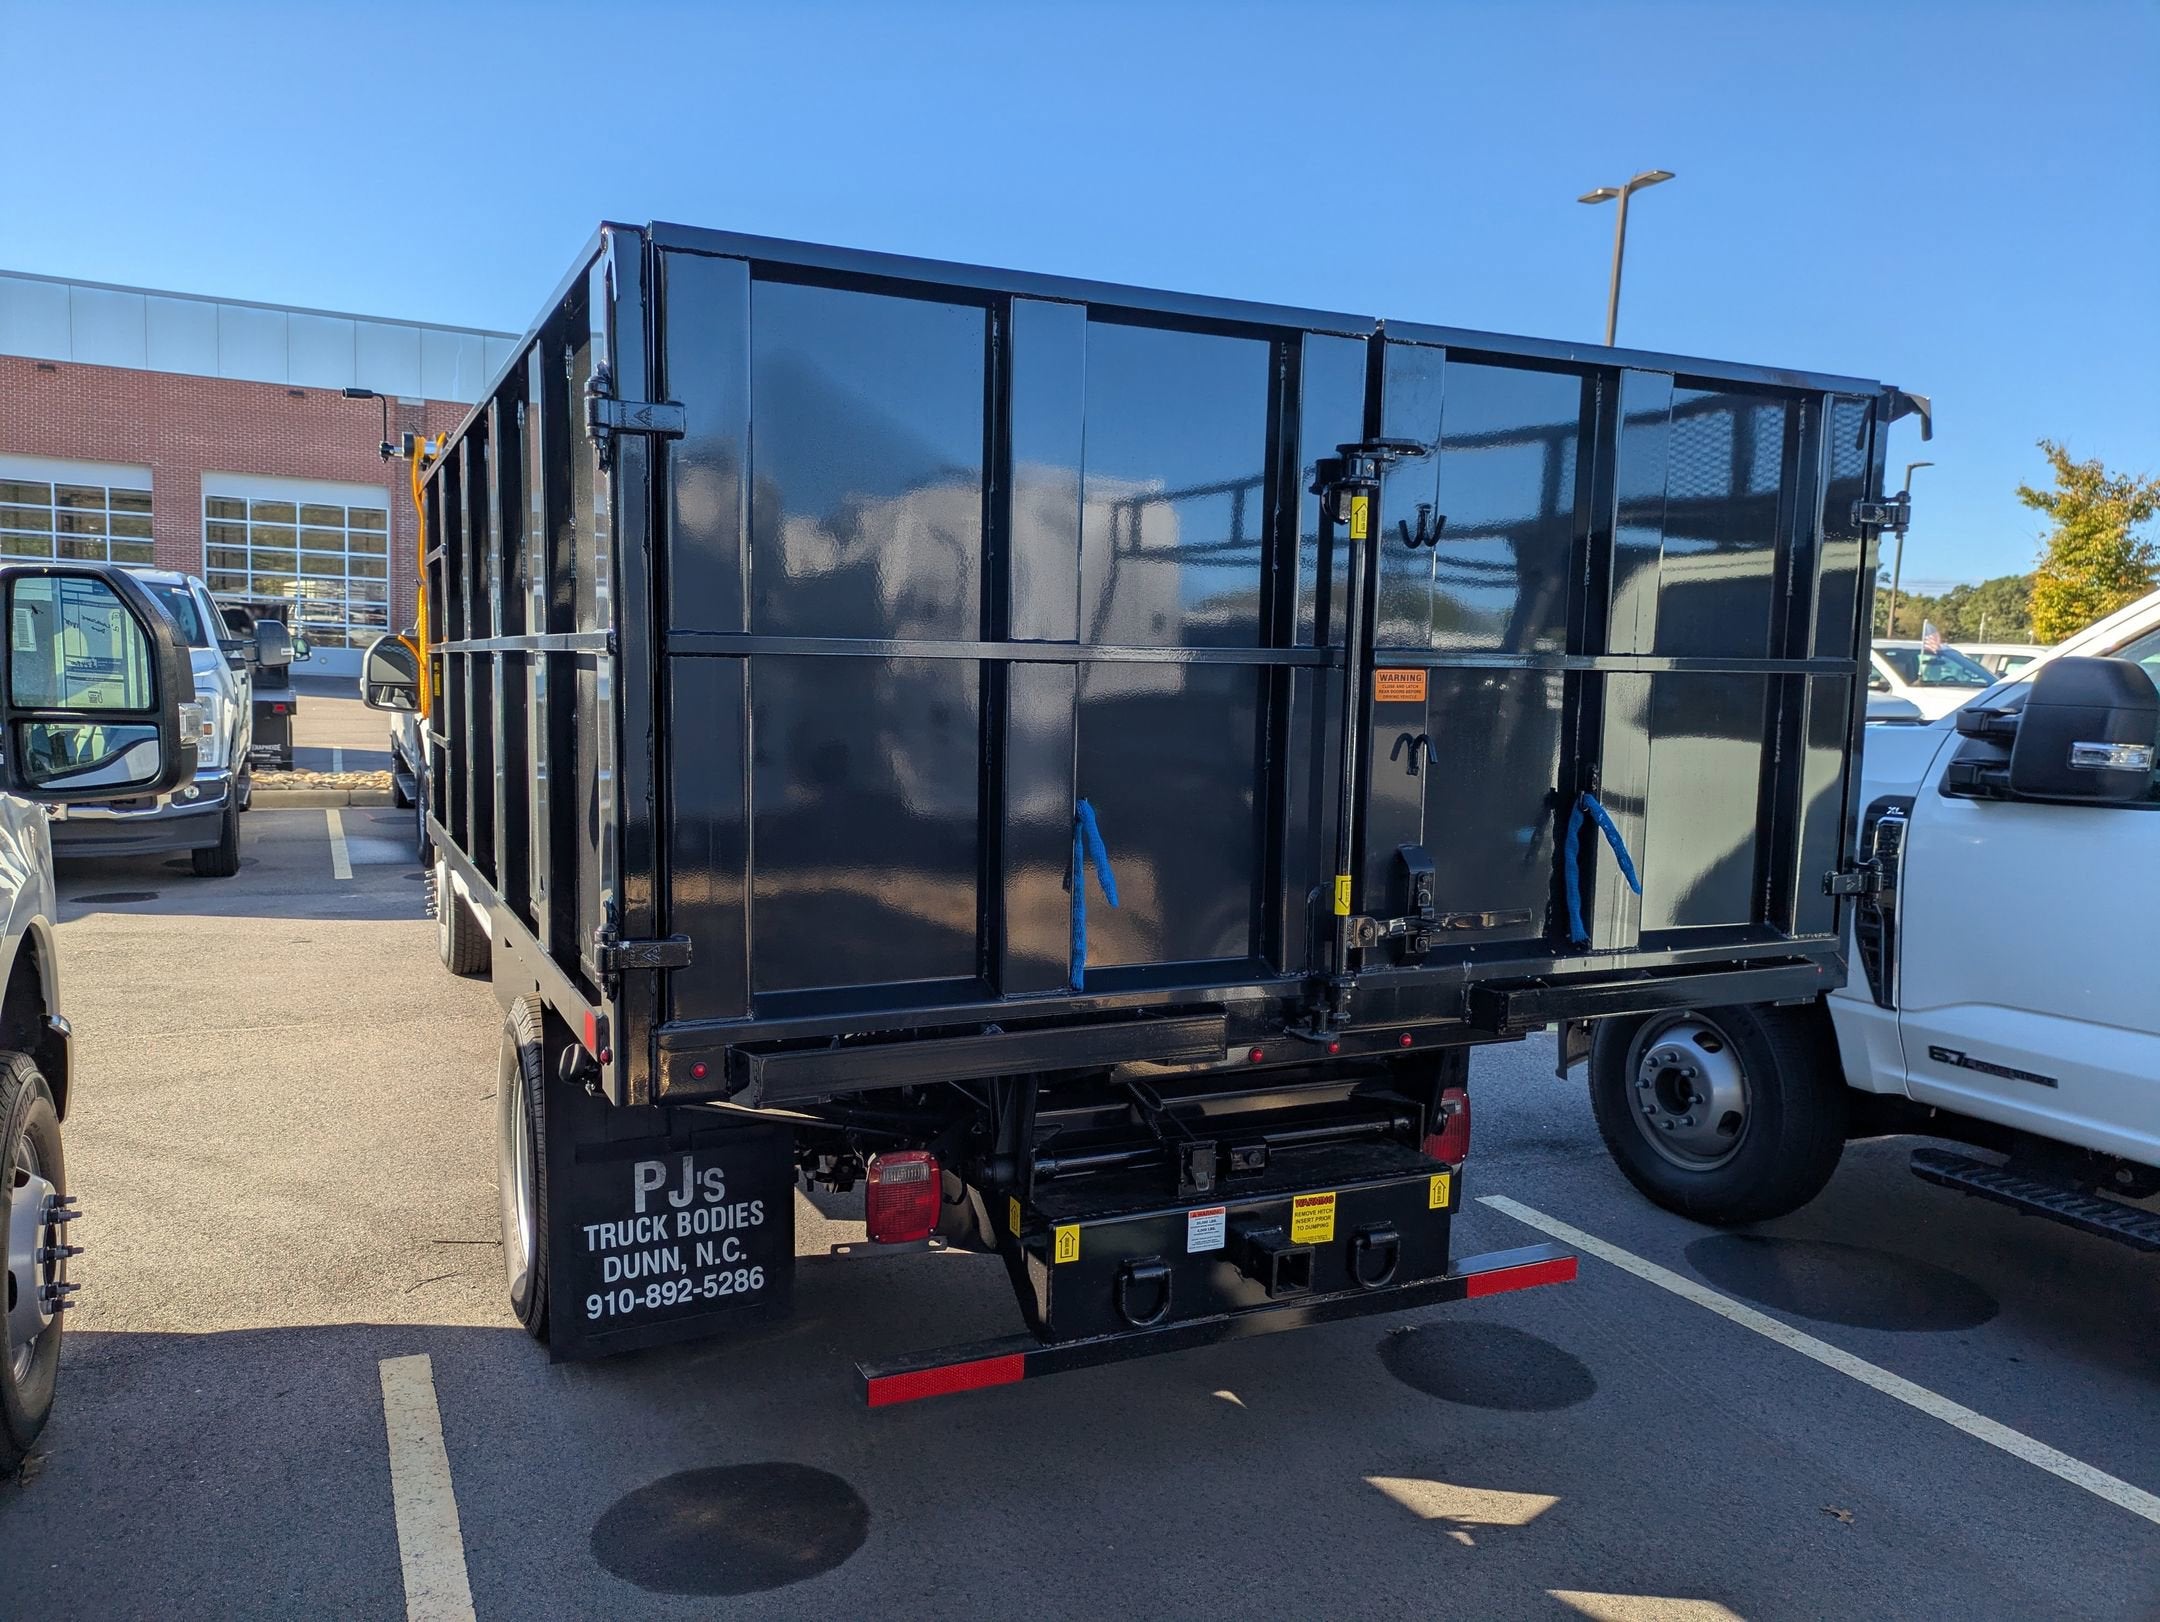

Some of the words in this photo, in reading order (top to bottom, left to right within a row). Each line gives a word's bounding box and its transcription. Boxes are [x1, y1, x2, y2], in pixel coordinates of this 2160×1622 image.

[1379, 674, 1422, 682] WARNING
[1886, 806, 1904, 815] XL
[1295, 1196, 1334, 1208] WARNING
[583, 1214, 669, 1252] TRUCK
[677, 1200, 764, 1238] BODIES
[603, 1246, 687, 1283] DUNN,
[696, 1237, 747, 1268] N.C.
[586, 1265, 765, 1320] 910-892-5286
